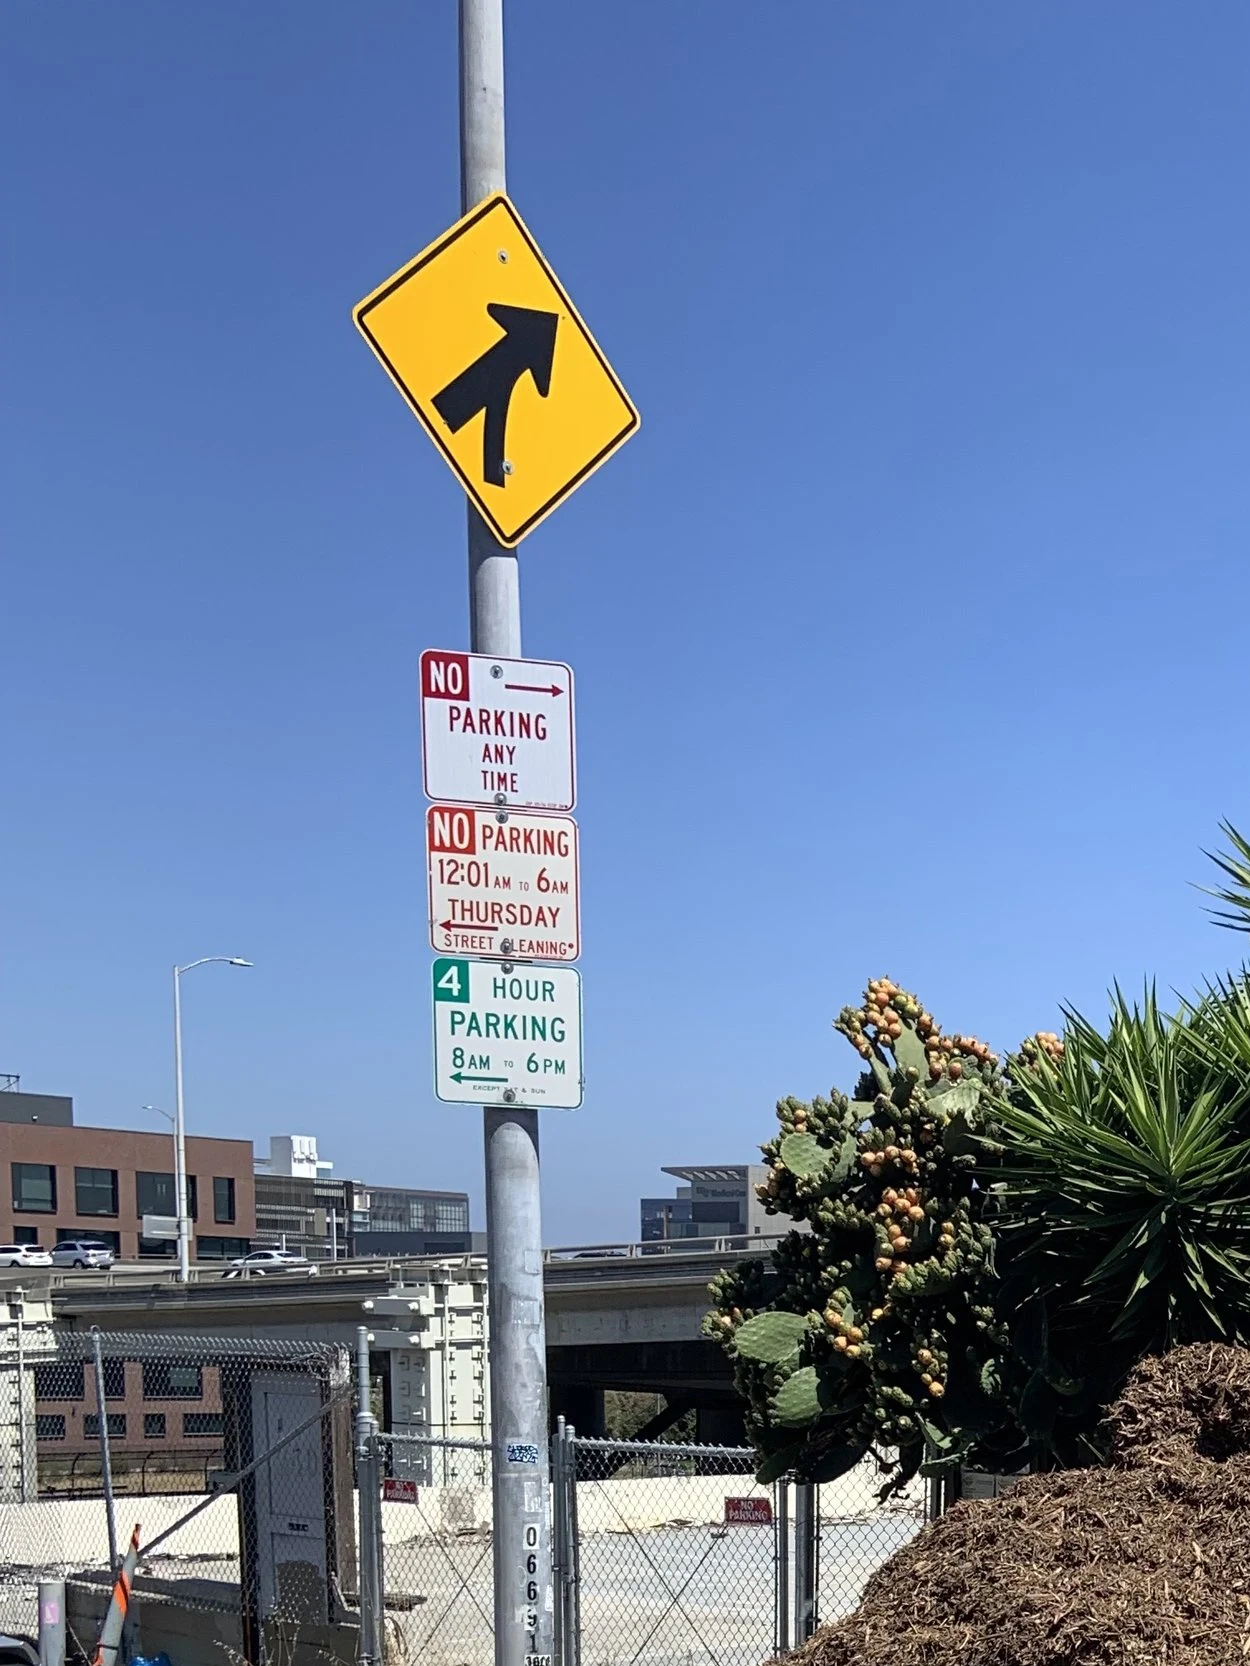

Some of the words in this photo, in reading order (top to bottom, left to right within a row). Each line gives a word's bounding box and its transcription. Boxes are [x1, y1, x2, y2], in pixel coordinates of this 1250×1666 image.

[430, 660, 463, 695] NO
[449, 705, 547, 741] PARKING
[482, 743, 516, 765] ANY
[481, 770, 518, 793] TIME
[433, 811, 470, 849] NO
[482, 824, 569, 857] PARKING
[519, 881, 530, 891] TO
[448, 898, 560, 928] THURSDAY
[444, 934, 494, 950] STREET
[437, 966, 461, 996] 4
[493, 977, 555, 1002] HOUR
[450, 1010, 565, 1042] PARKING
[504, 1060, 514, 1068] TO
[740, 1500, 754, 1510] NO
